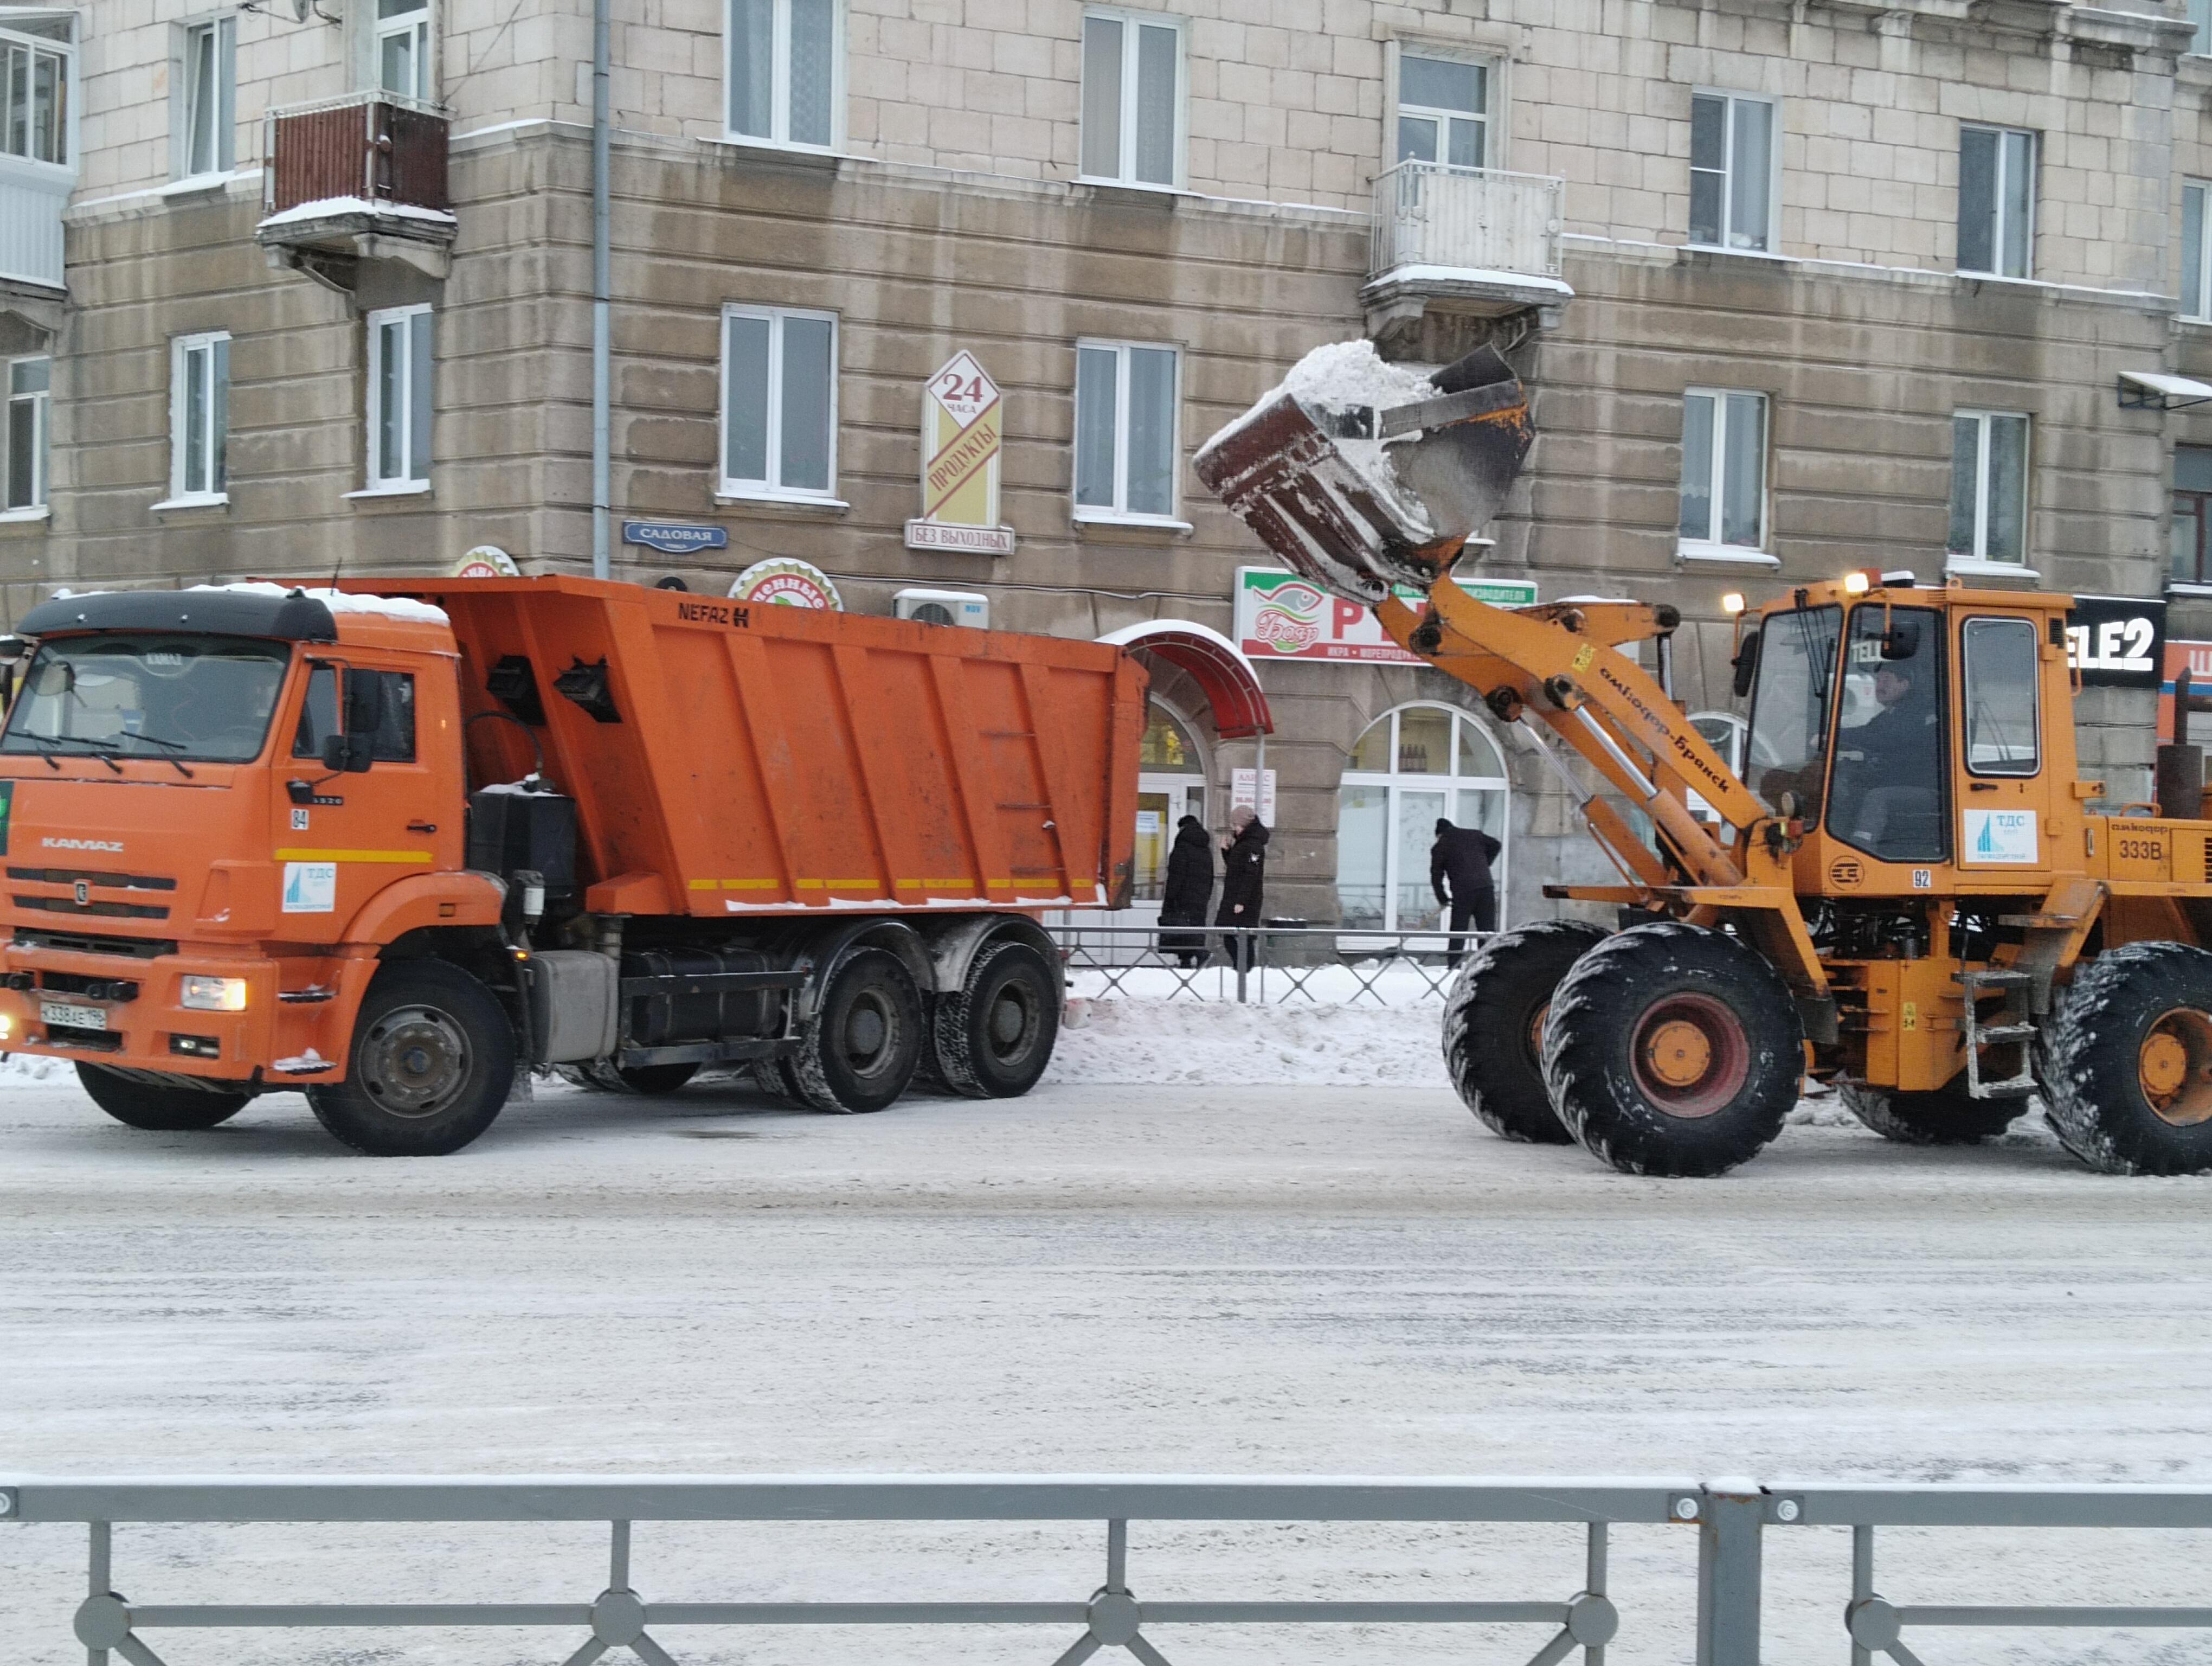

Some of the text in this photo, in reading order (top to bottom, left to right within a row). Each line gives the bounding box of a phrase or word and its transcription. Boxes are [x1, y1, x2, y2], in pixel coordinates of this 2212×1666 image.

[942, 374, 984, 403] 24
[947, 403, 976, 414] ЧАСА
[928, 423, 998, 491] ПРОДУКТЫ
[640, 528, 712, 541] САДОВАЯ
[915, 528, 1007, 549] БЕЗ ВЫХОДНЫХ
[1996, 815, 2025, 828] ТДС
[42, 838, 124, 852] KAMAZ
[307, 868, 335, 880] ТДС
[1915, 870, 1930, 887] 92
